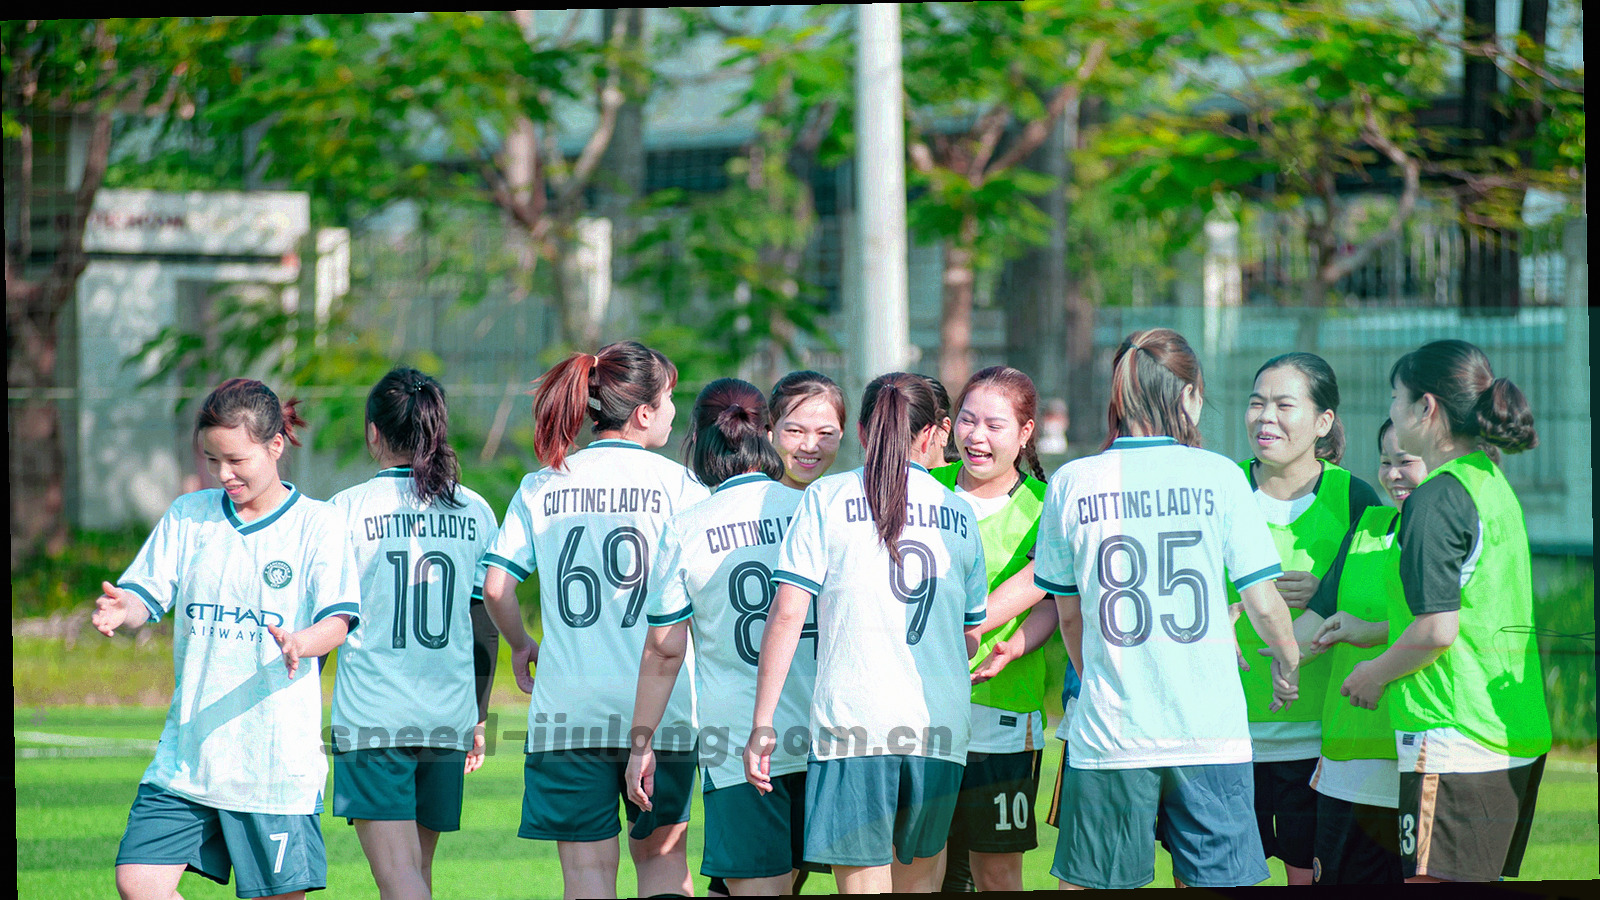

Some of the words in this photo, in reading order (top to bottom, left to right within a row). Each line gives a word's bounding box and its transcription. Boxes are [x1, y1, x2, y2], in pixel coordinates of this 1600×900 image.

[543, 488, 607, 517] CUTTING
[609, 488, 662, 514] LADYS
[918, 503, 968, 539] LADYS
[1077, 490, 1152, 525] CUTTING
[1155, 487, 1214, 517] LADYS
[364, 513, 427, 541] CUTTING
[429, 513, 477, 541] LADYS
[706, 518, 777, 554] CUTTING
[556, 525, 650, 629] 69
[888, 539, 937, 646] 9
[1097, 530, 1210, 648] 85
[185, 602, 284, 628] ETIHAD
[386, 550, 456, 650] 10
[190, 625, 264, 643] AIRWAYS
[993, 791, 1028, 831] 10
[269, 832, 289, 873] 7
[1398, 813, 1416, 856] 3
